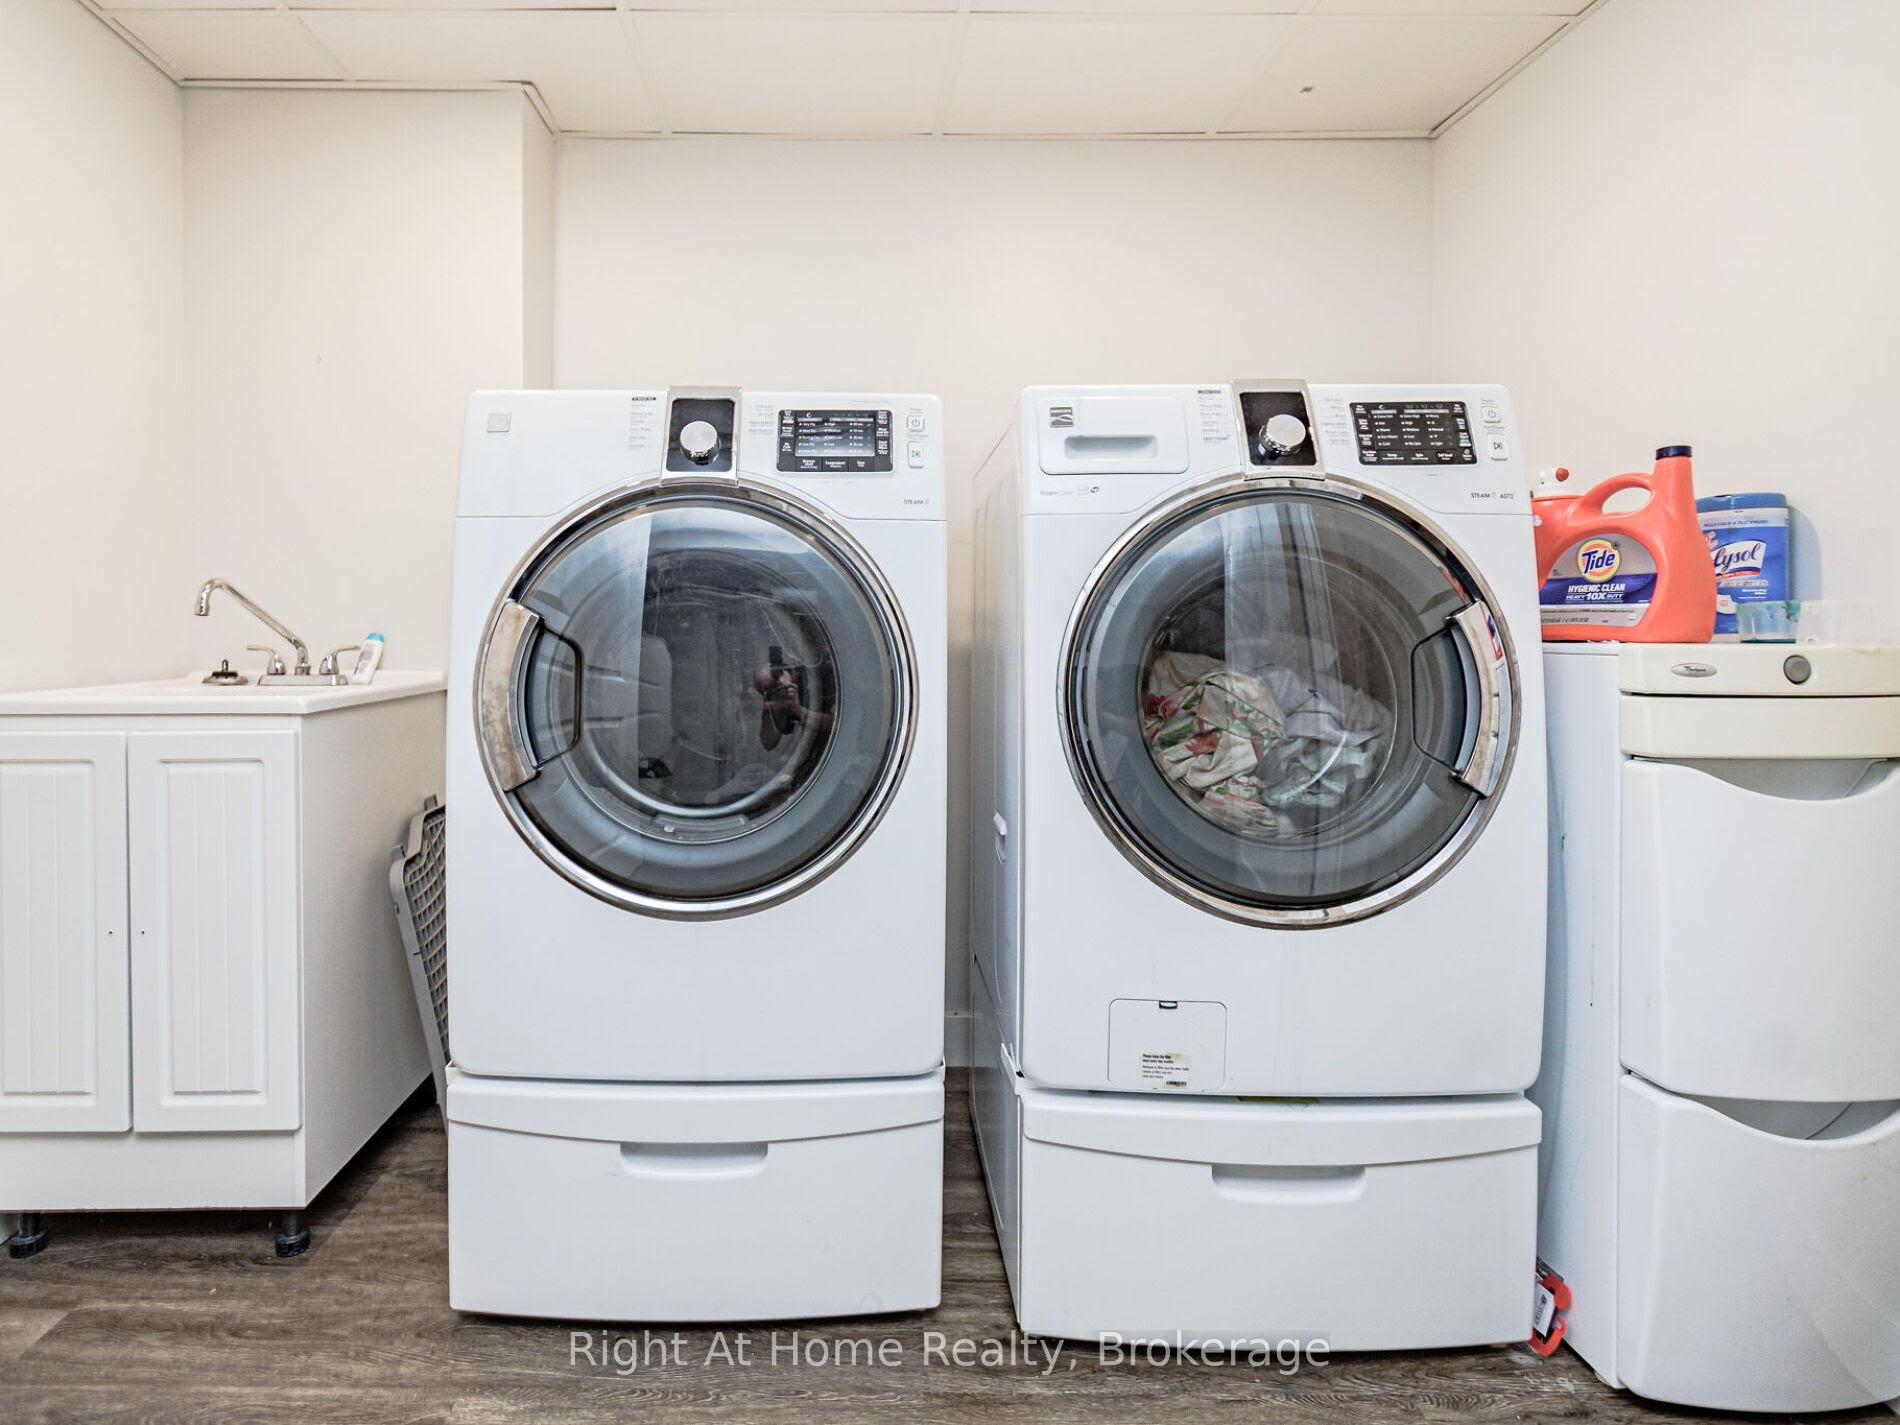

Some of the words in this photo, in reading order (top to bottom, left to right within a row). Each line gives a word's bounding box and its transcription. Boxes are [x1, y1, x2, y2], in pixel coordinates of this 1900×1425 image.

[1582, 549, 1616, 575] Tide
[1714, 542, 1762, 572] Lysol
[1568, 584, 1601, 593] HYGIENIC
[1601, 583, 1626, 592] CLEAN
[1586, 592, 1607, 600] 10X
